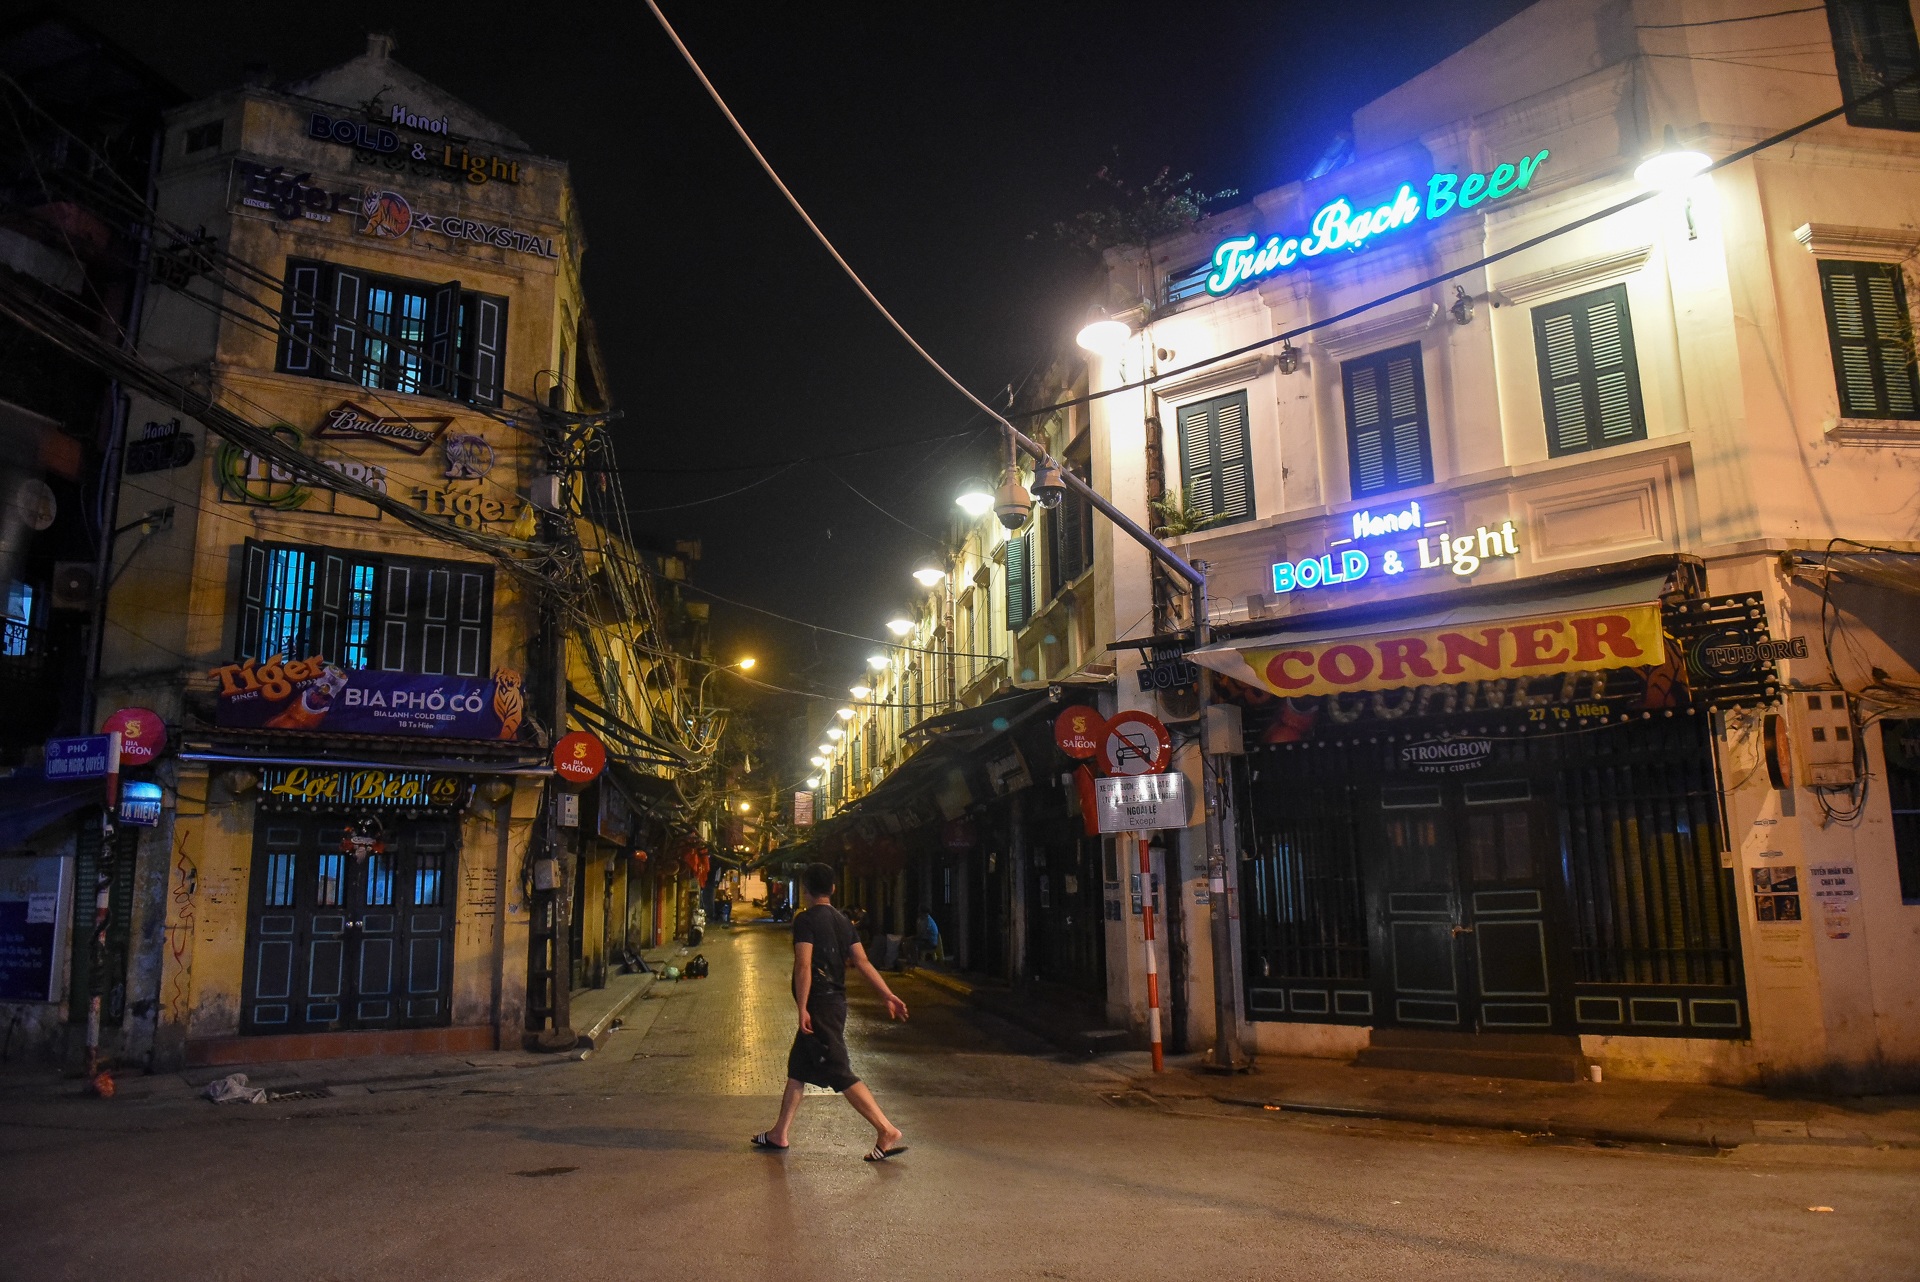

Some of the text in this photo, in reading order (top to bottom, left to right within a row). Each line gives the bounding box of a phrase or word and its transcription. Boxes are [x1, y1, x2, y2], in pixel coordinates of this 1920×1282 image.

[391, 104, 449, 136] Hanoi
[309, 112, 520, 184] BOLD & Light
[234, 159, 351, 220] Tiger
[244, 199, 331, 222] SINCE 1932
[1206, 149, 1550, 295] Trúc Bạch Beer
[441, 217, 559, 260] CRYSTAL
[143, 419, 176, 440] Hanoi
[329, 409, 436, 441] Budweiser
[409, 479, 521, 532] Tiger
[1352, 501, 1421, 539] Hanoi
[1272, 520, 1520, 593] BOLD & Light
[1265, 615, 1644, 690] CORNER
[1705, 636, 1809, 668] TUBORG
[207, 652, 326, 703] Tiger
[1136, 662, 1199, 692] BOLD
[231, 690, 259, 704] SINCE
[344, 687, 484, 713] BIA PHỐ CỔ
[398, 720, 408, 728] 18
[1527, 708, 1546, 721] 27
[120, 745, 153, 756] AIGON
[1062, 740, 1097, 749] SAIGON
[1401, 740, 1492, 762] STRONGBOW
[561, 762, 593, 774] SAIGON
[1417, 760, 1482, 773] APPLE CIDERS
[271, 766, 458, 803] Lợi Béo 18
[1129, 817, 1156, 826] Except
